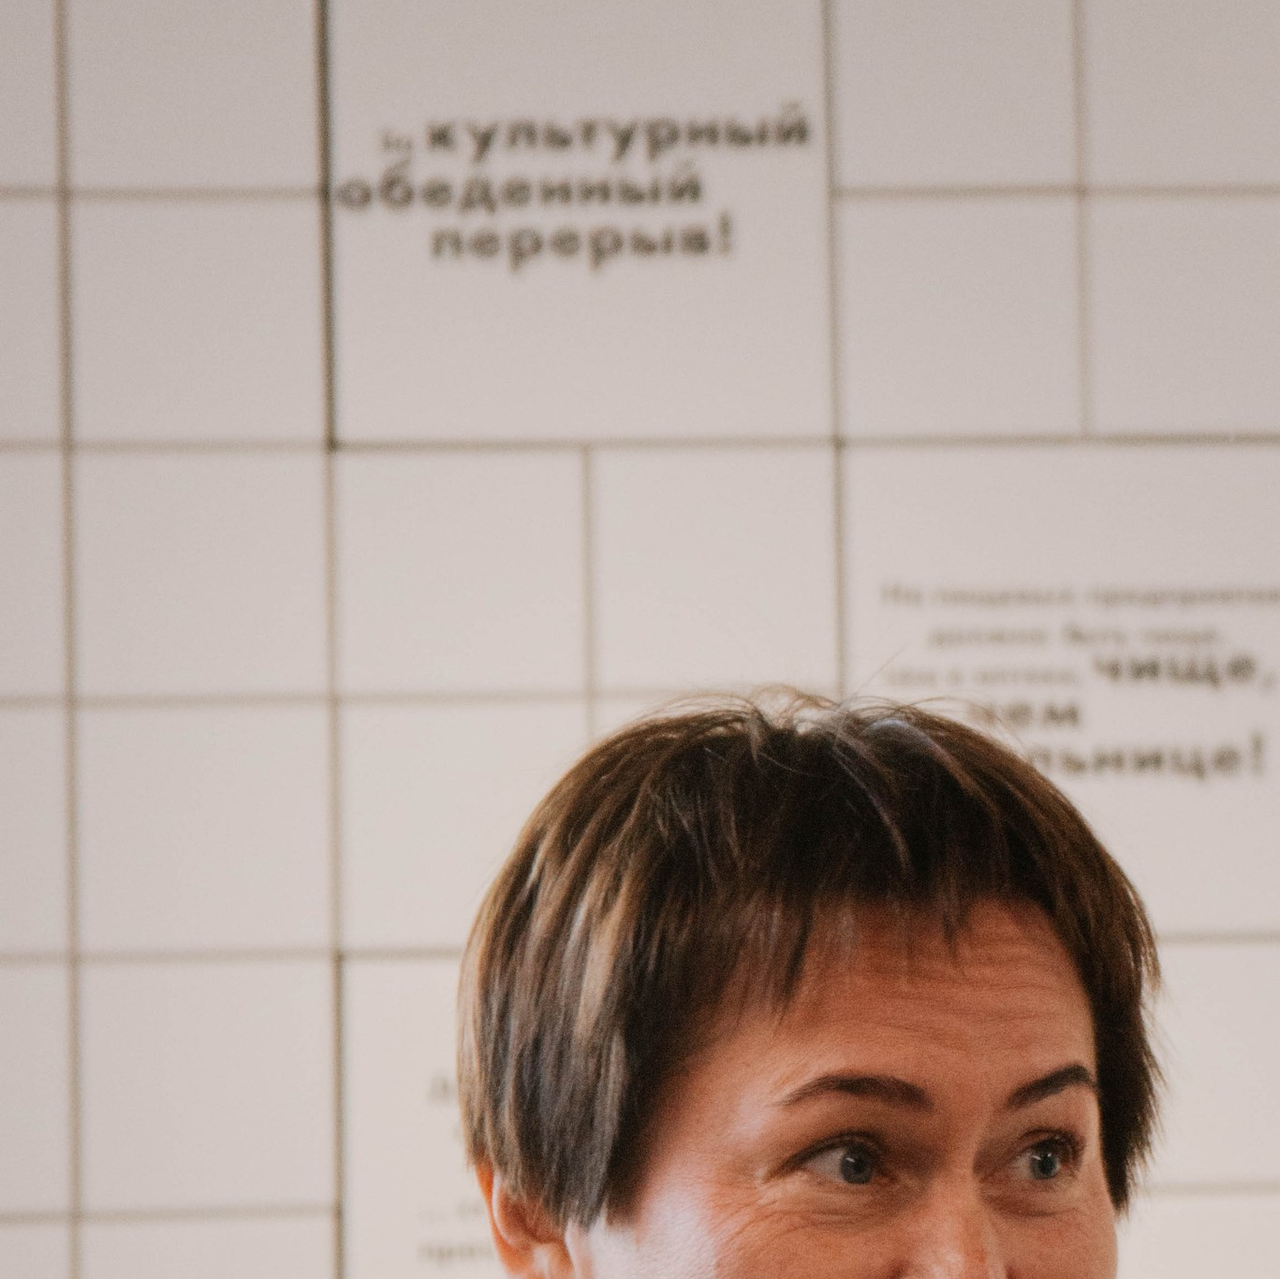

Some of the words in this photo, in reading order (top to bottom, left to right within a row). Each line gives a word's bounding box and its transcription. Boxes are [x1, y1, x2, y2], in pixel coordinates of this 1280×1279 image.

[426, 101, 811, 163] культурный
[337, 160, 703, 214] обеденный
[431, 211, 731, 274] перерыв!
